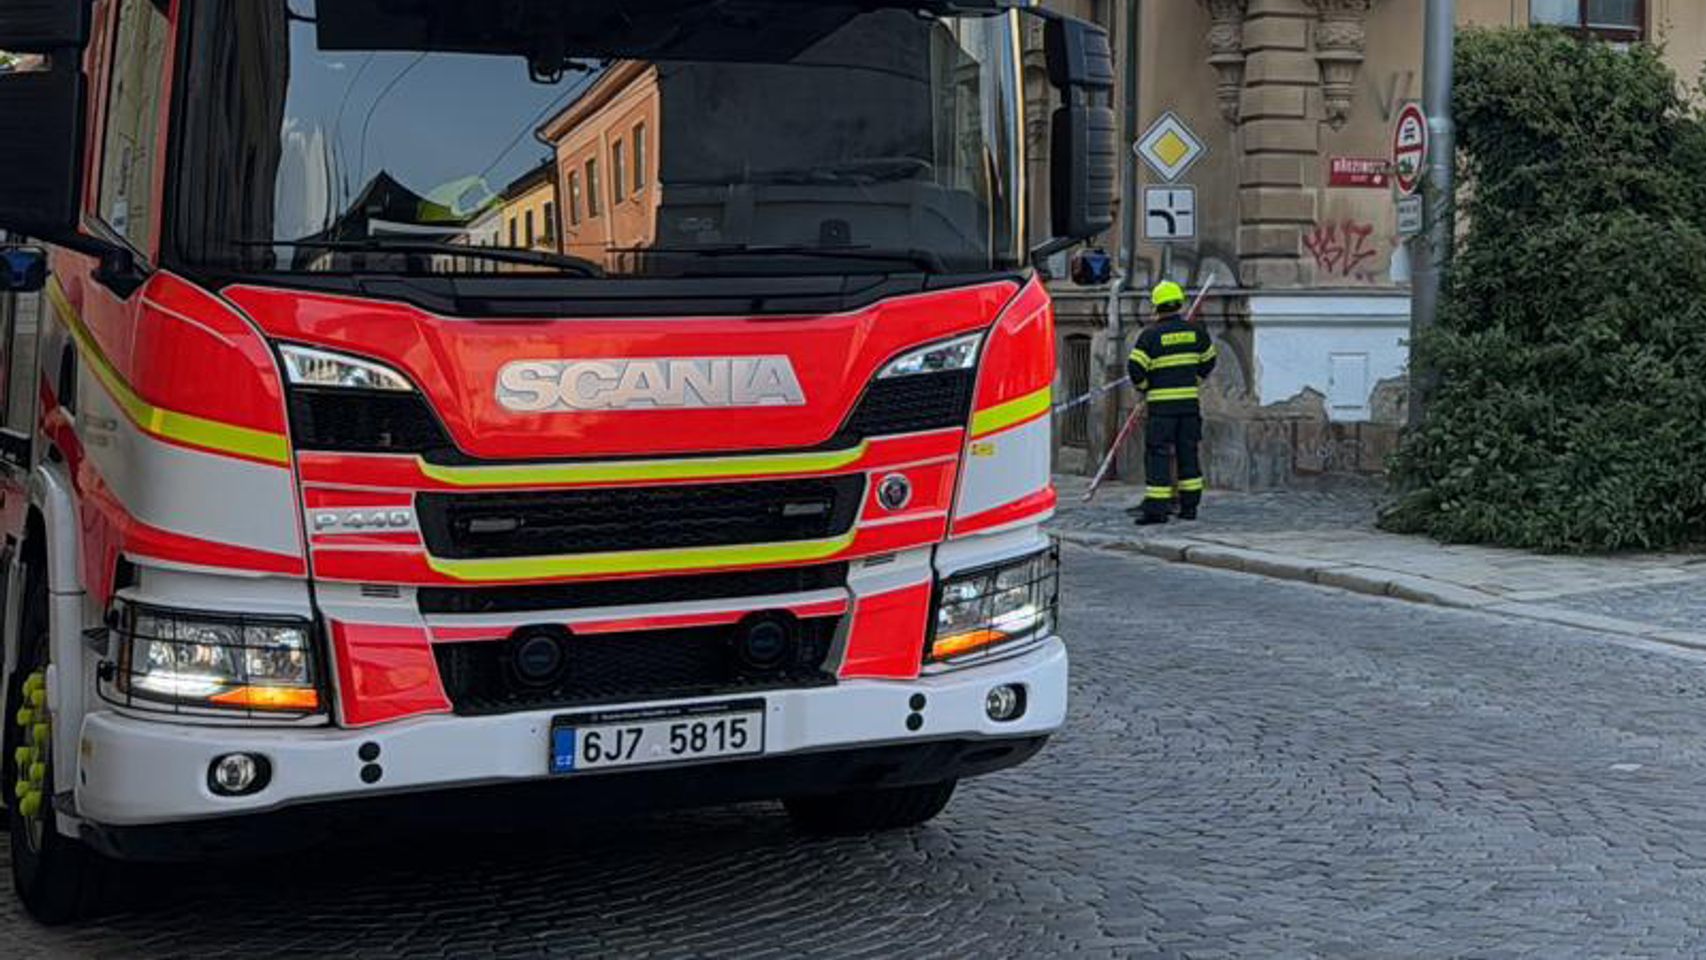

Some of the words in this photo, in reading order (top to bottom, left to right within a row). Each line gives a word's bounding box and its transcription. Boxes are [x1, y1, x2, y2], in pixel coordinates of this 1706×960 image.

[498, 356, 804, 410] SCANIA
[341, 510, 411, 529] 440
[583, 727, 645, 763] 6J7
[669, 717, 749, 755] 5815
